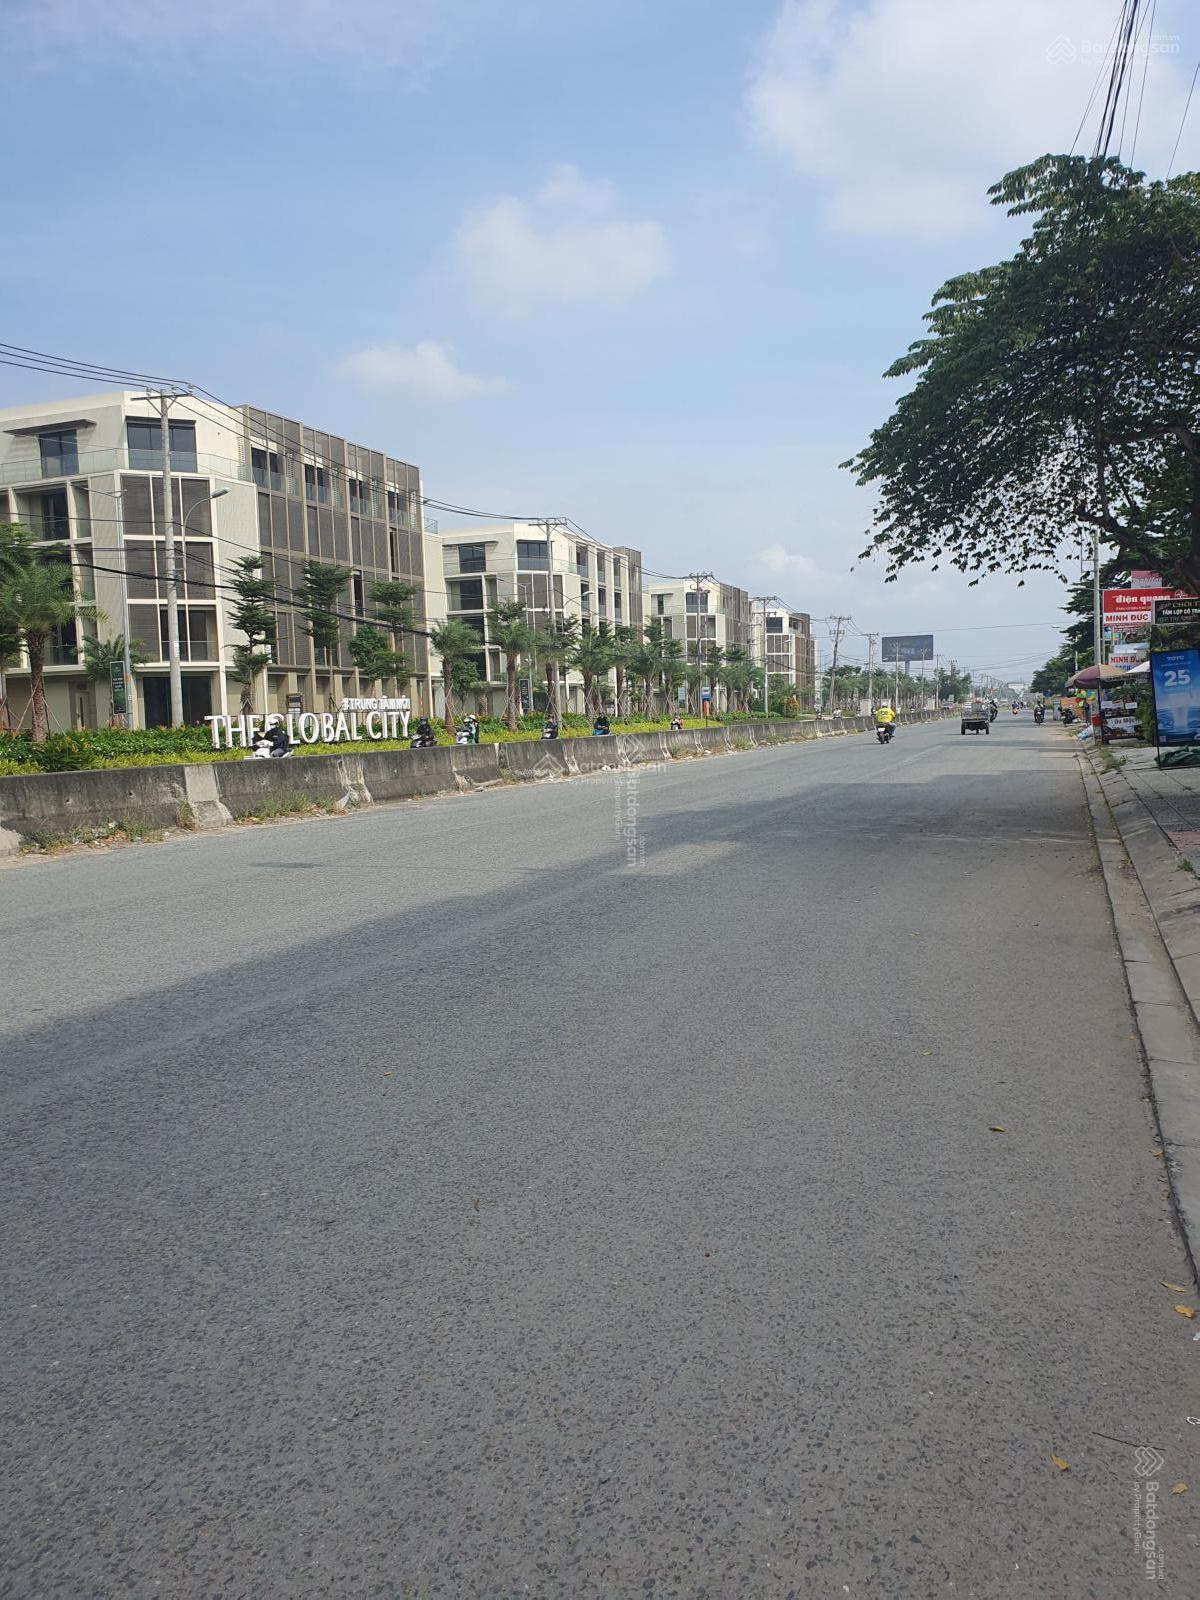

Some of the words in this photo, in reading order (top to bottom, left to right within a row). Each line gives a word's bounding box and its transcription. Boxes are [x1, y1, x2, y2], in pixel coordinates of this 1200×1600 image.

[1106, 614, 1128, 622] MINH
[1164, 669, 1191, 687] 25
[204, 714, 261, 749] THE
[365, 710, 411, 740] CITY
